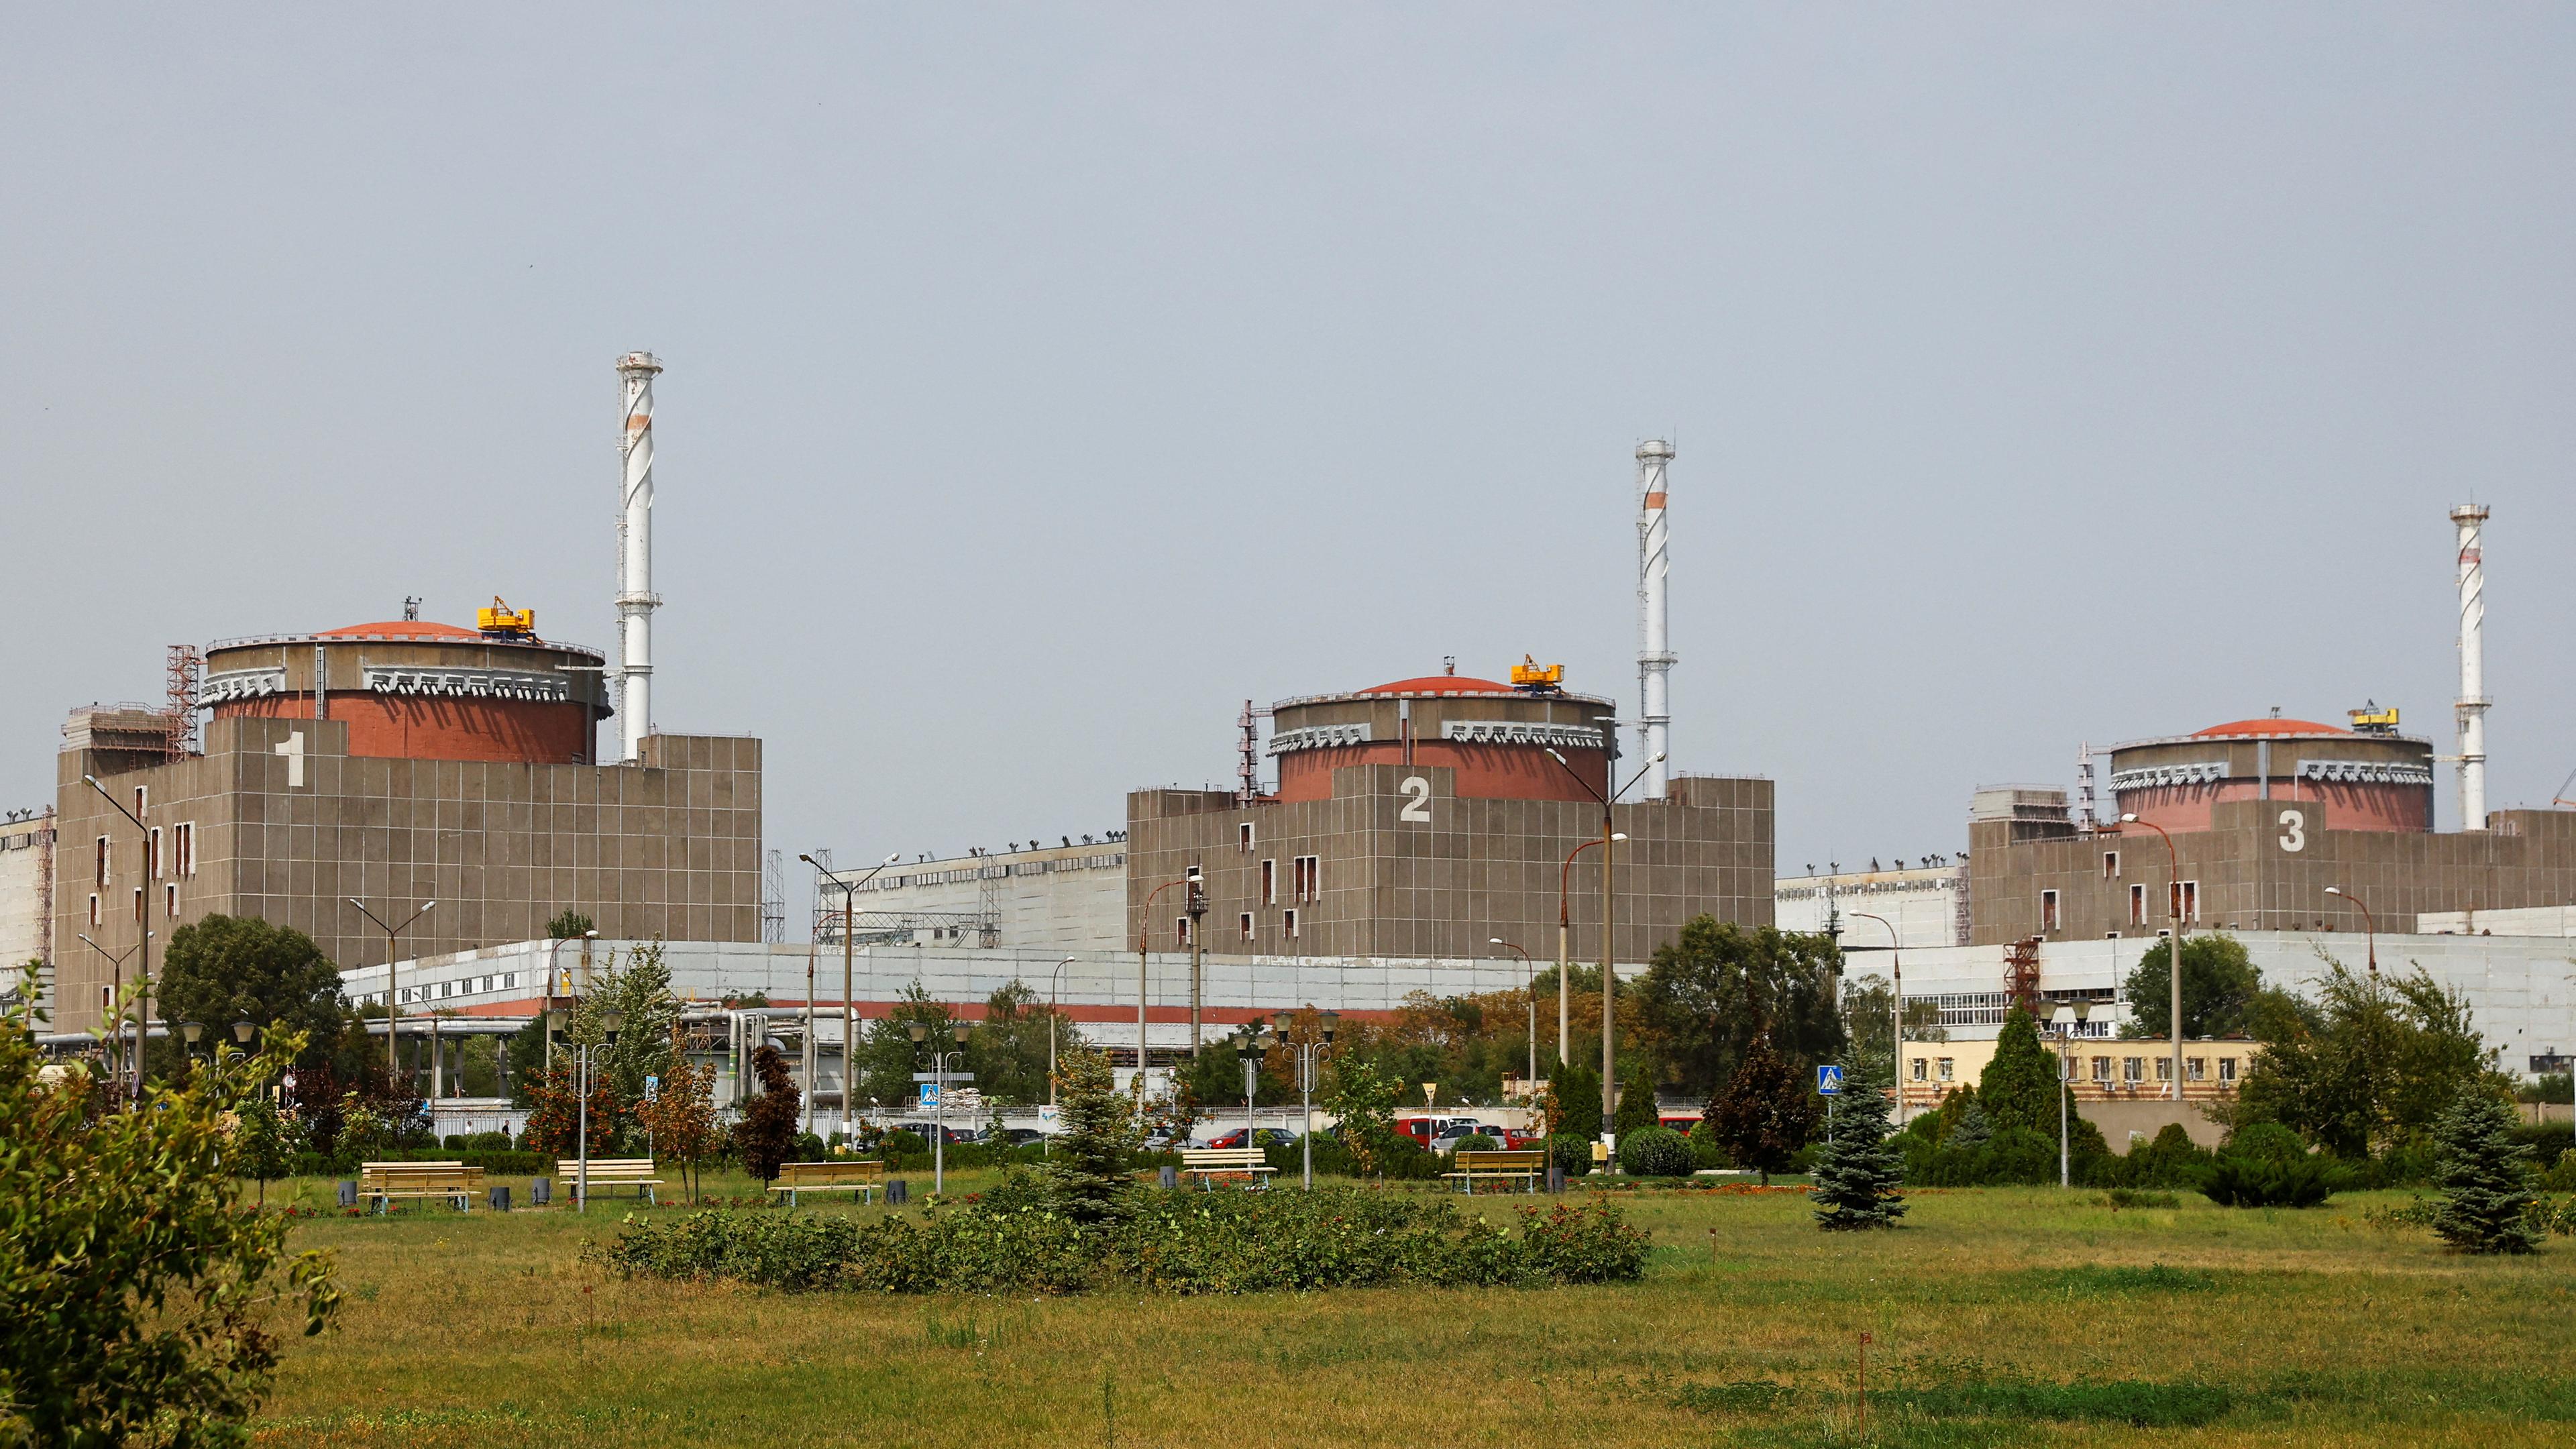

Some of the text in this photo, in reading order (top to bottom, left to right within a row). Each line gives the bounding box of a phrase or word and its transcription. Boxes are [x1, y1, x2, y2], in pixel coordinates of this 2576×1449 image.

[276, 732, 304, 787] 1
[1401, 777, 1430, 822] 2
[2280, 810, 2305, 852] 3
